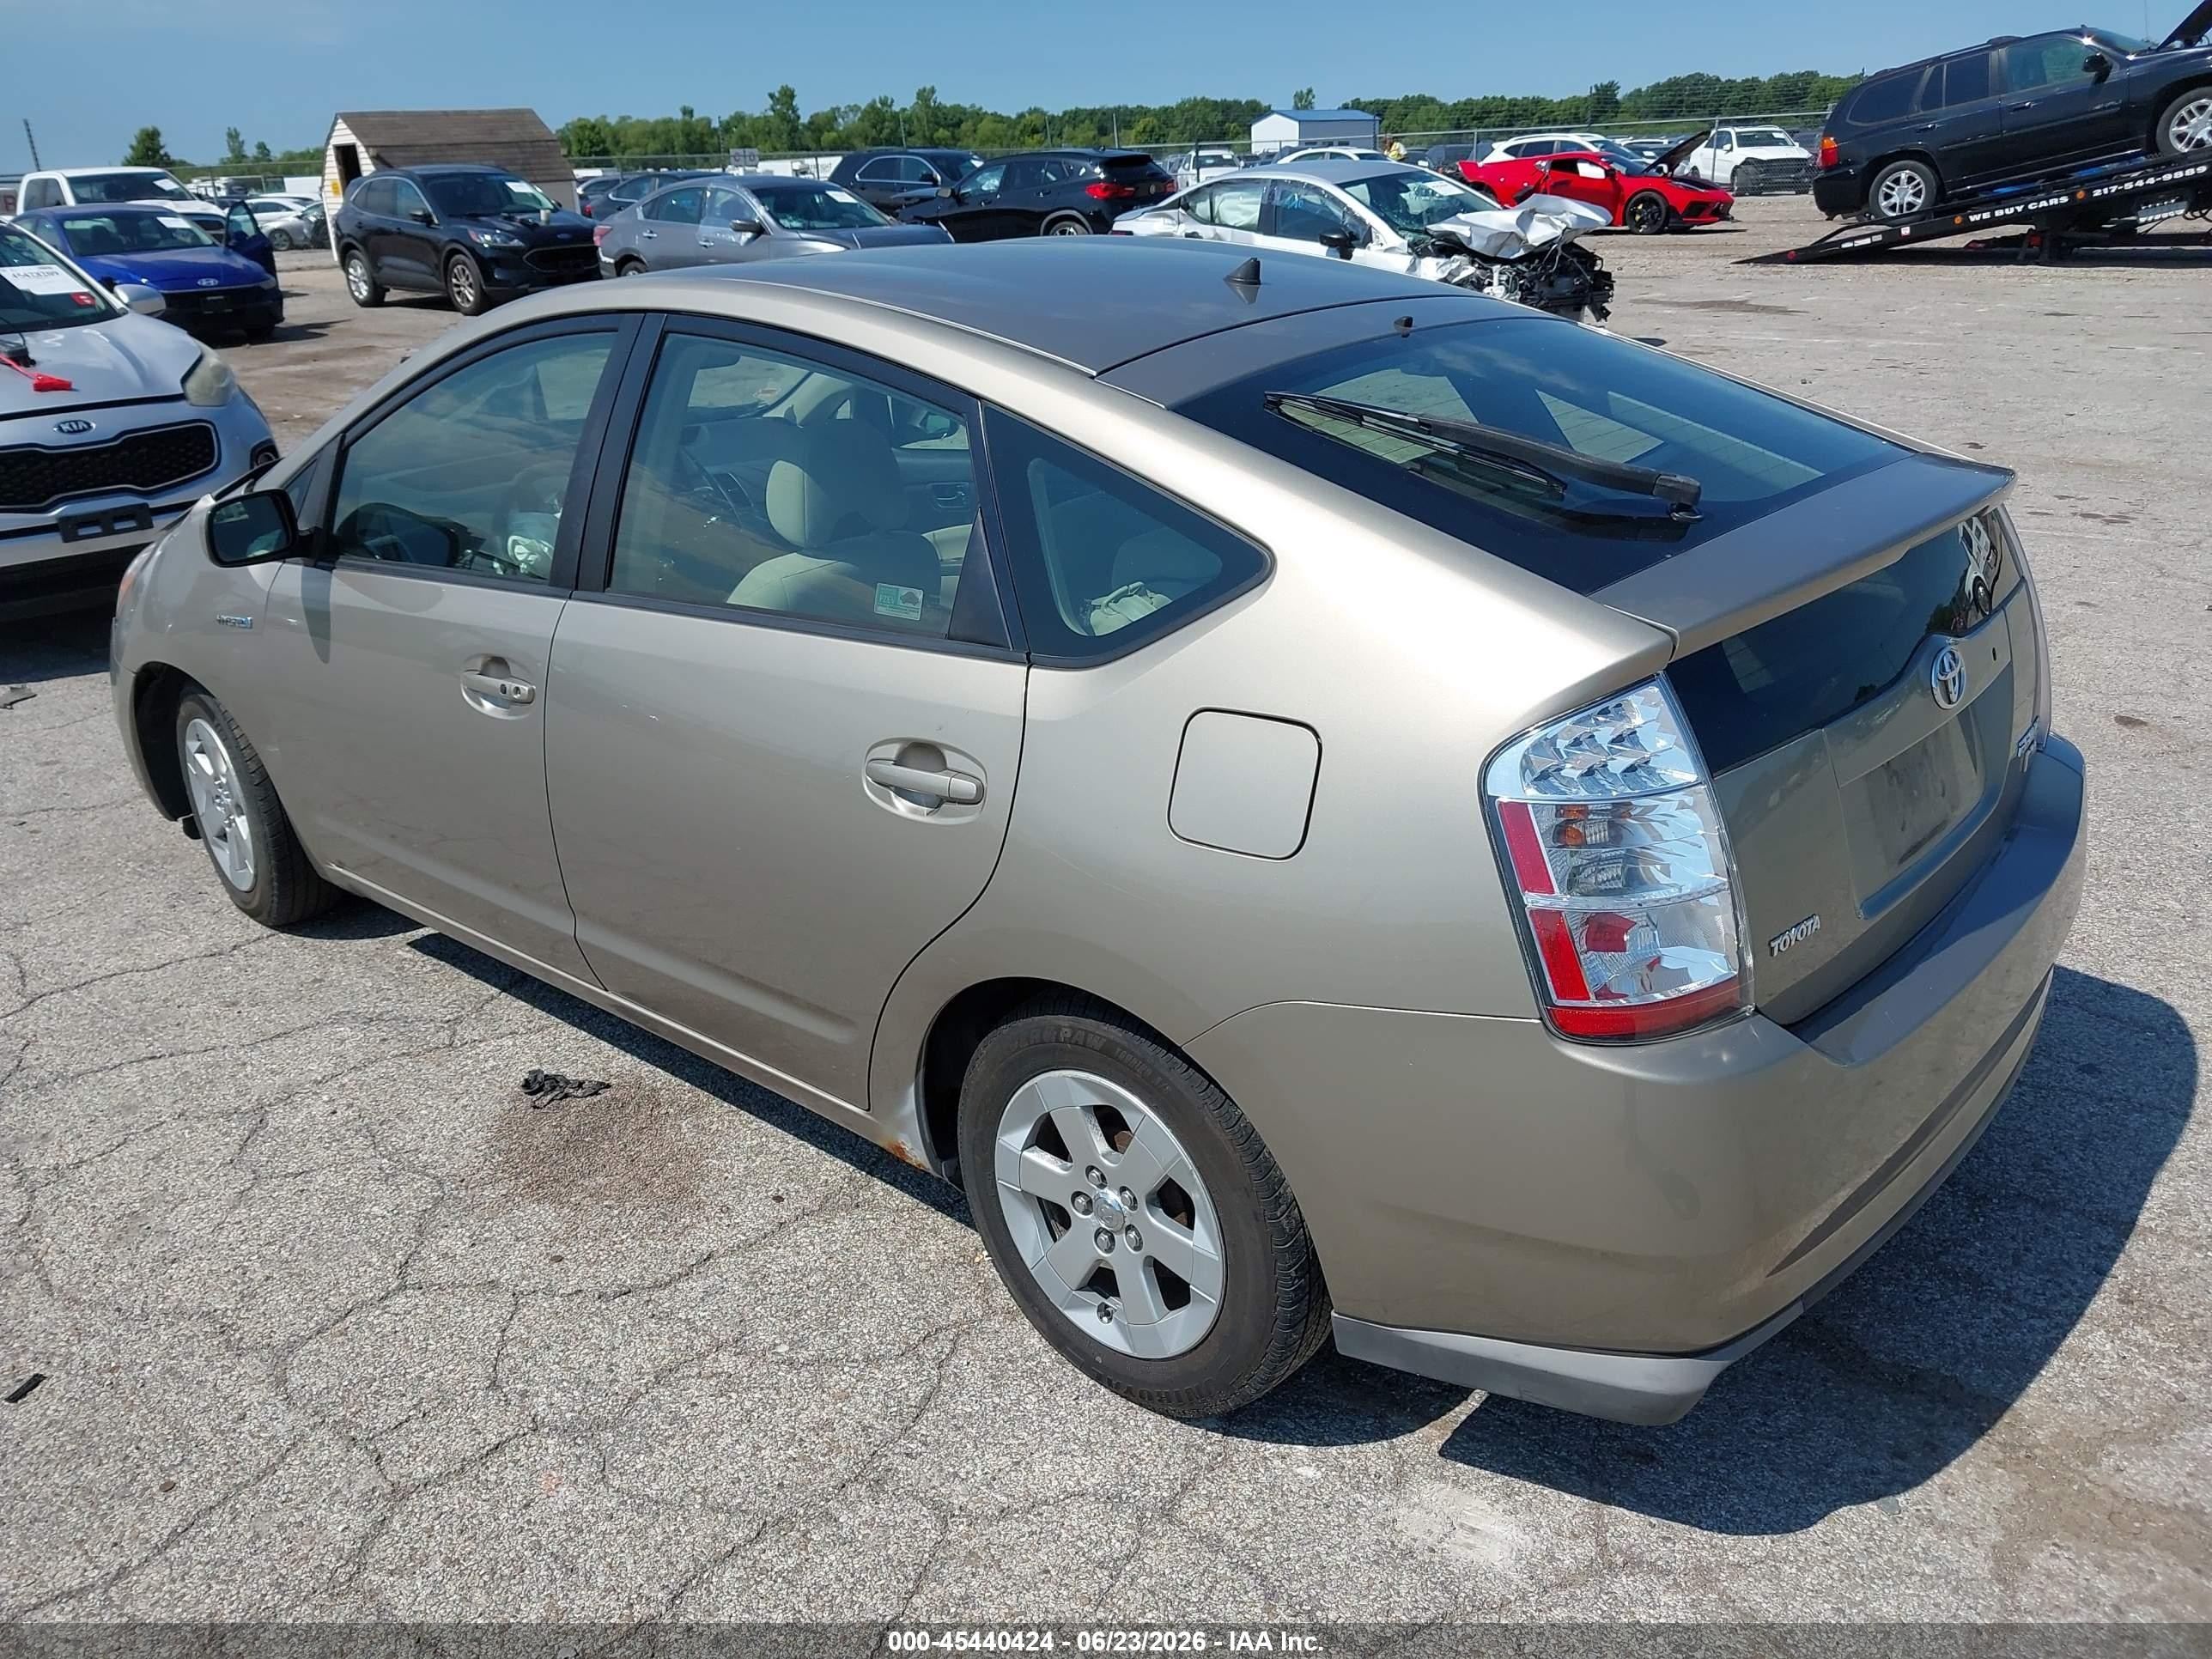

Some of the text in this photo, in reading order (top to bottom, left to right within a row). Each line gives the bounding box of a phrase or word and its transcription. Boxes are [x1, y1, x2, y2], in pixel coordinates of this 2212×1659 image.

[1968, 165, 2209, 222] WE BUY CARS 217-544-9889
[60, 420, 88, 433] KIA
[1770, 914, 1821, 957] TOYOTA
